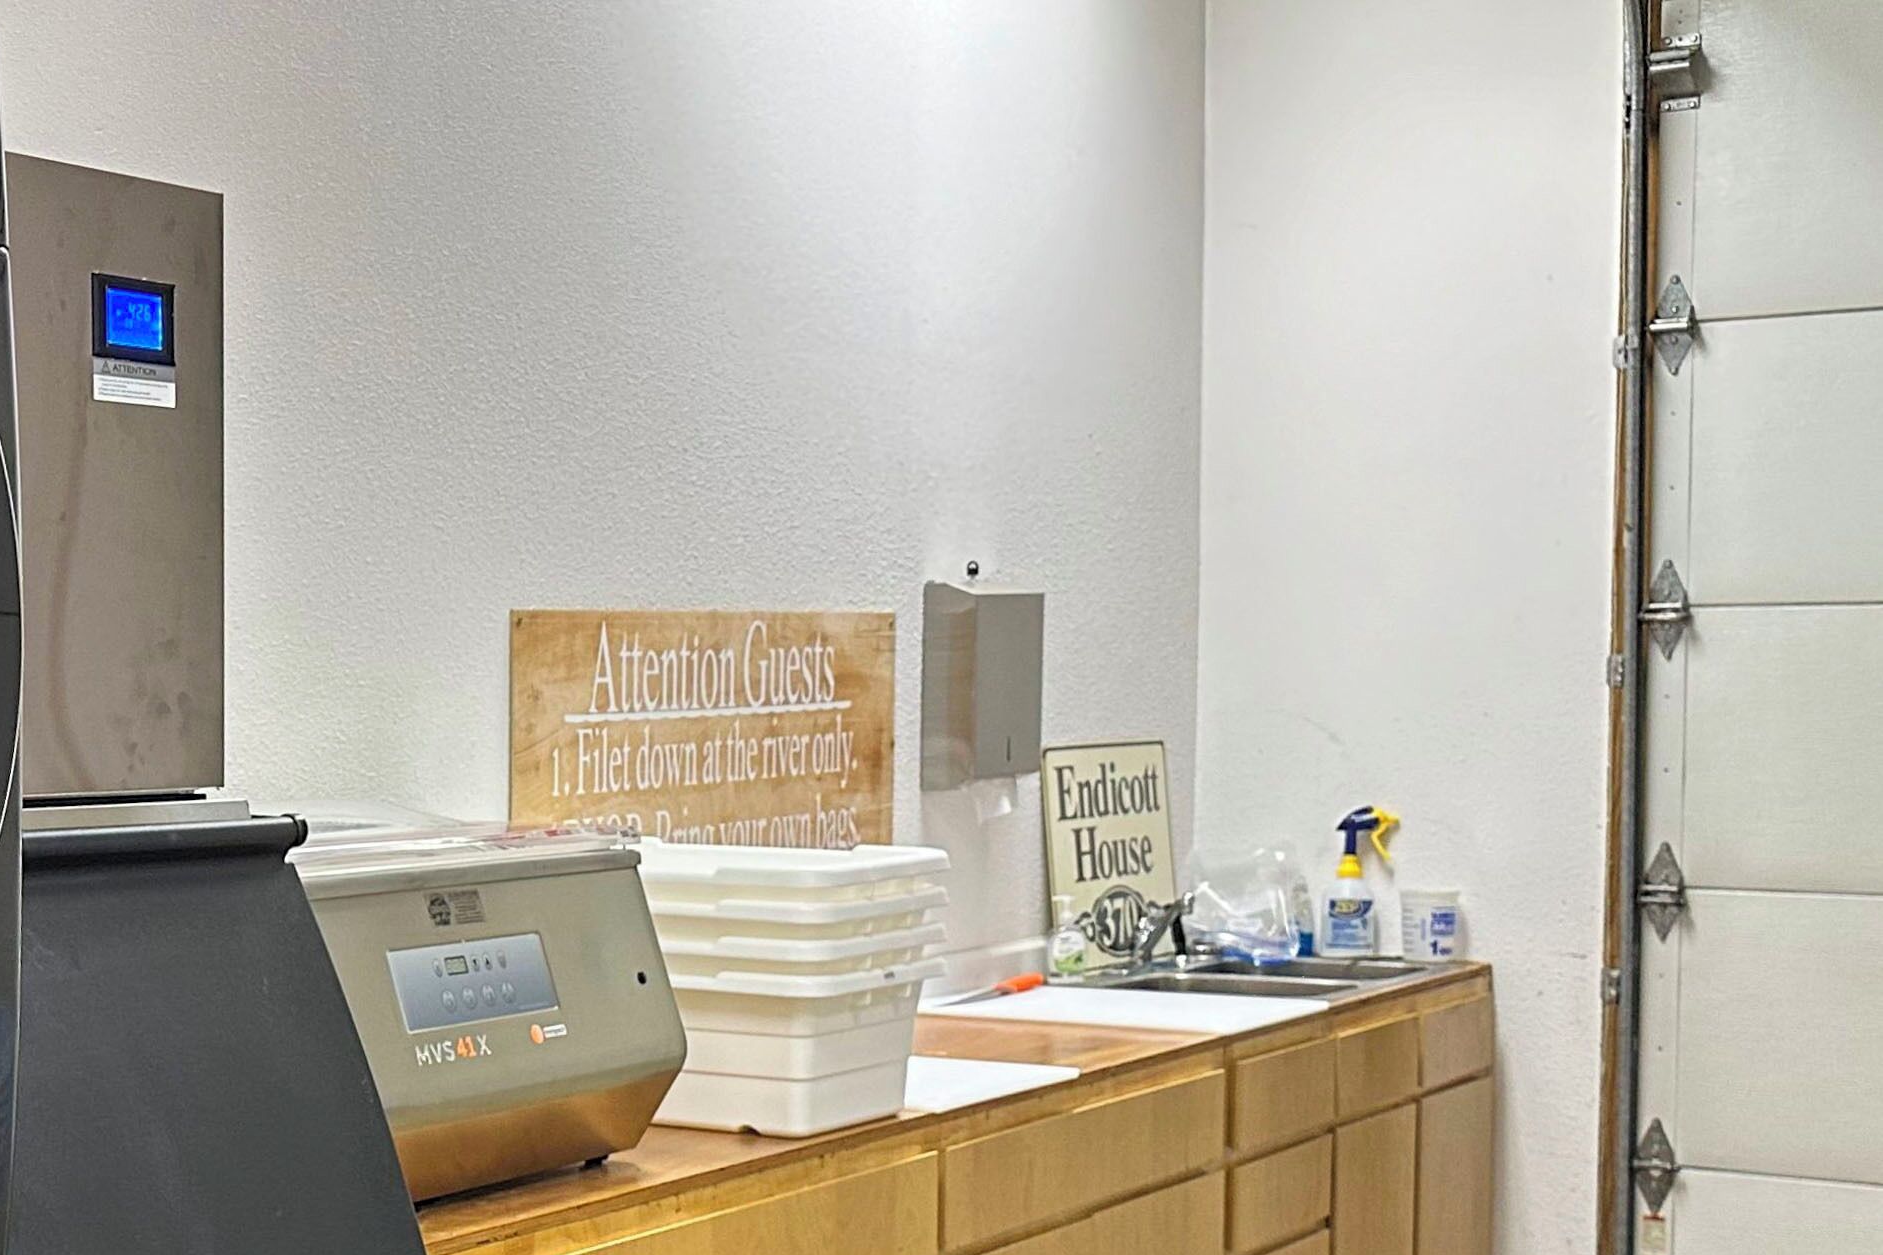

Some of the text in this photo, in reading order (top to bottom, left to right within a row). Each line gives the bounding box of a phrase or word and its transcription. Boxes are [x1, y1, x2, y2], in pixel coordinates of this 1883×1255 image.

[112, 364, 157, 377] ATTENTION
[588, 619, 836, 714] Attention Guests
[552, 714, 858, 797] 1. Filet down at the river only.
[1054, 761, 1160, 821] Endicott
[1072, 826, 1154, 883] House
